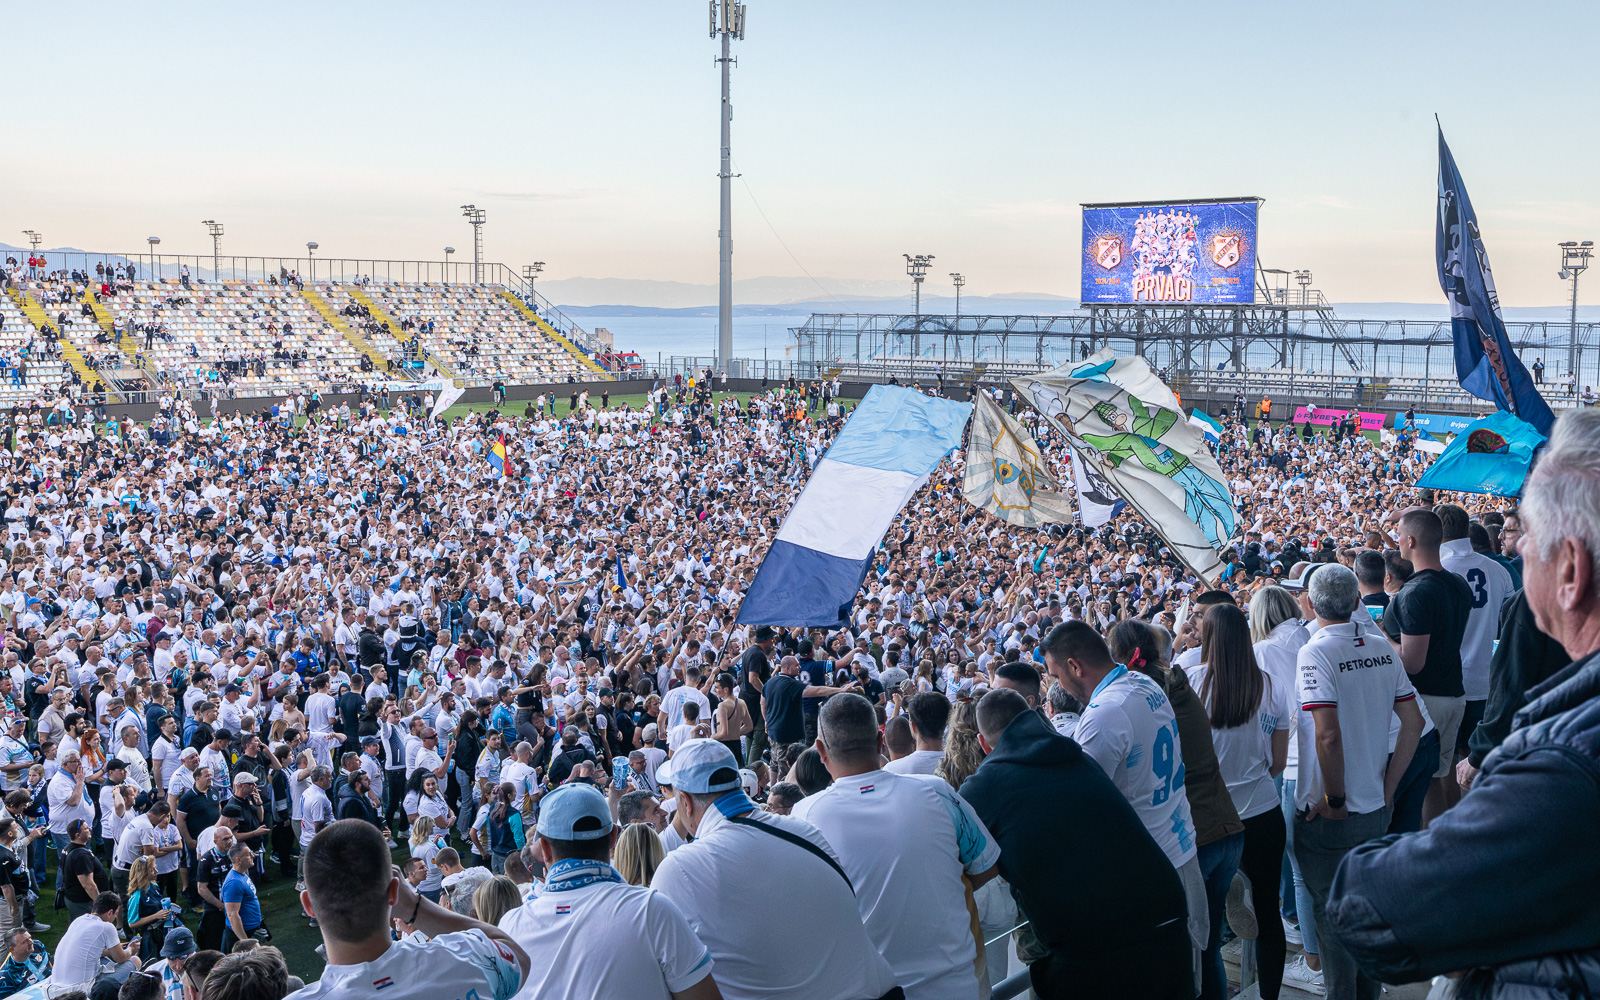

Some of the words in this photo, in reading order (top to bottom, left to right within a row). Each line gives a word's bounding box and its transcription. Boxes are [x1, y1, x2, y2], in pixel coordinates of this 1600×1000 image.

[1100, 240, 1120, 262] RIJEKA
[1215, 237, 1238, 261] RIJEKA
[1133, 275, 1192, 302] PRVACI
[1211, 277, 1240, 285] 2024/2025
[1466, 568, 1488, 608] 3
[1338, 655, 1393, 673] PETRONAS
